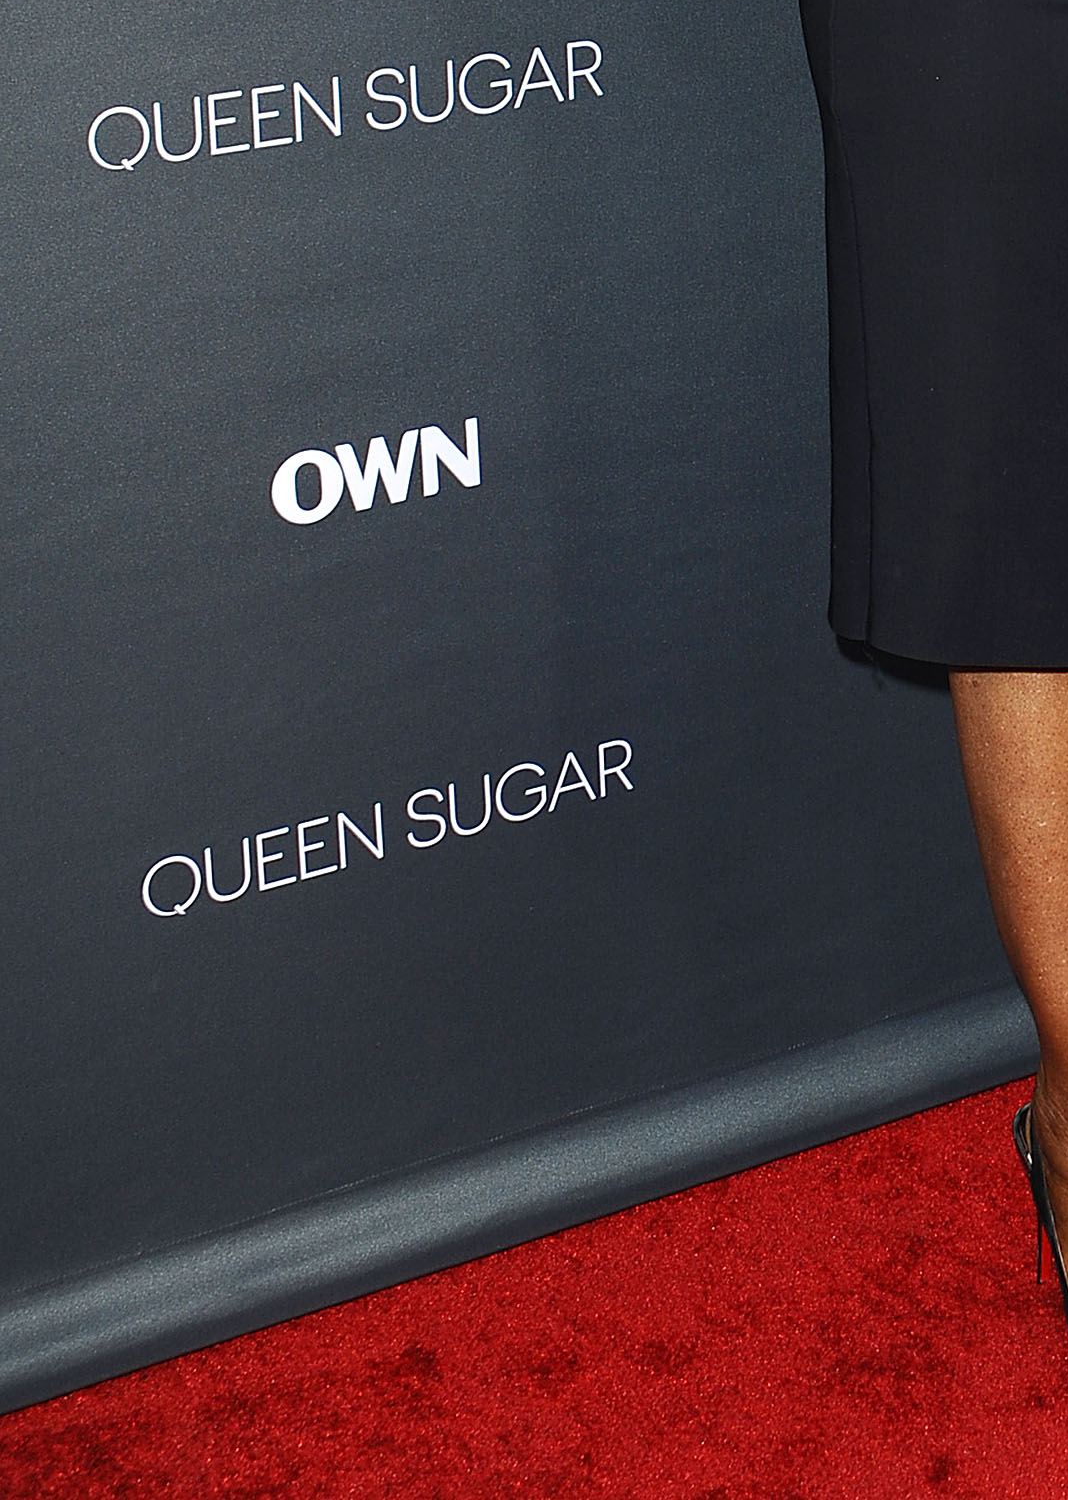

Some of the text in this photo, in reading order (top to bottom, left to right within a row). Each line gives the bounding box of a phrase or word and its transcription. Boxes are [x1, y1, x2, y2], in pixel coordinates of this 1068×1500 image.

[88, 40, 604, 171] QUEEN SUGAR
[271, 417, 481, 525] OWN
[142, 739, 634, 917] QUEEN SUGAR
